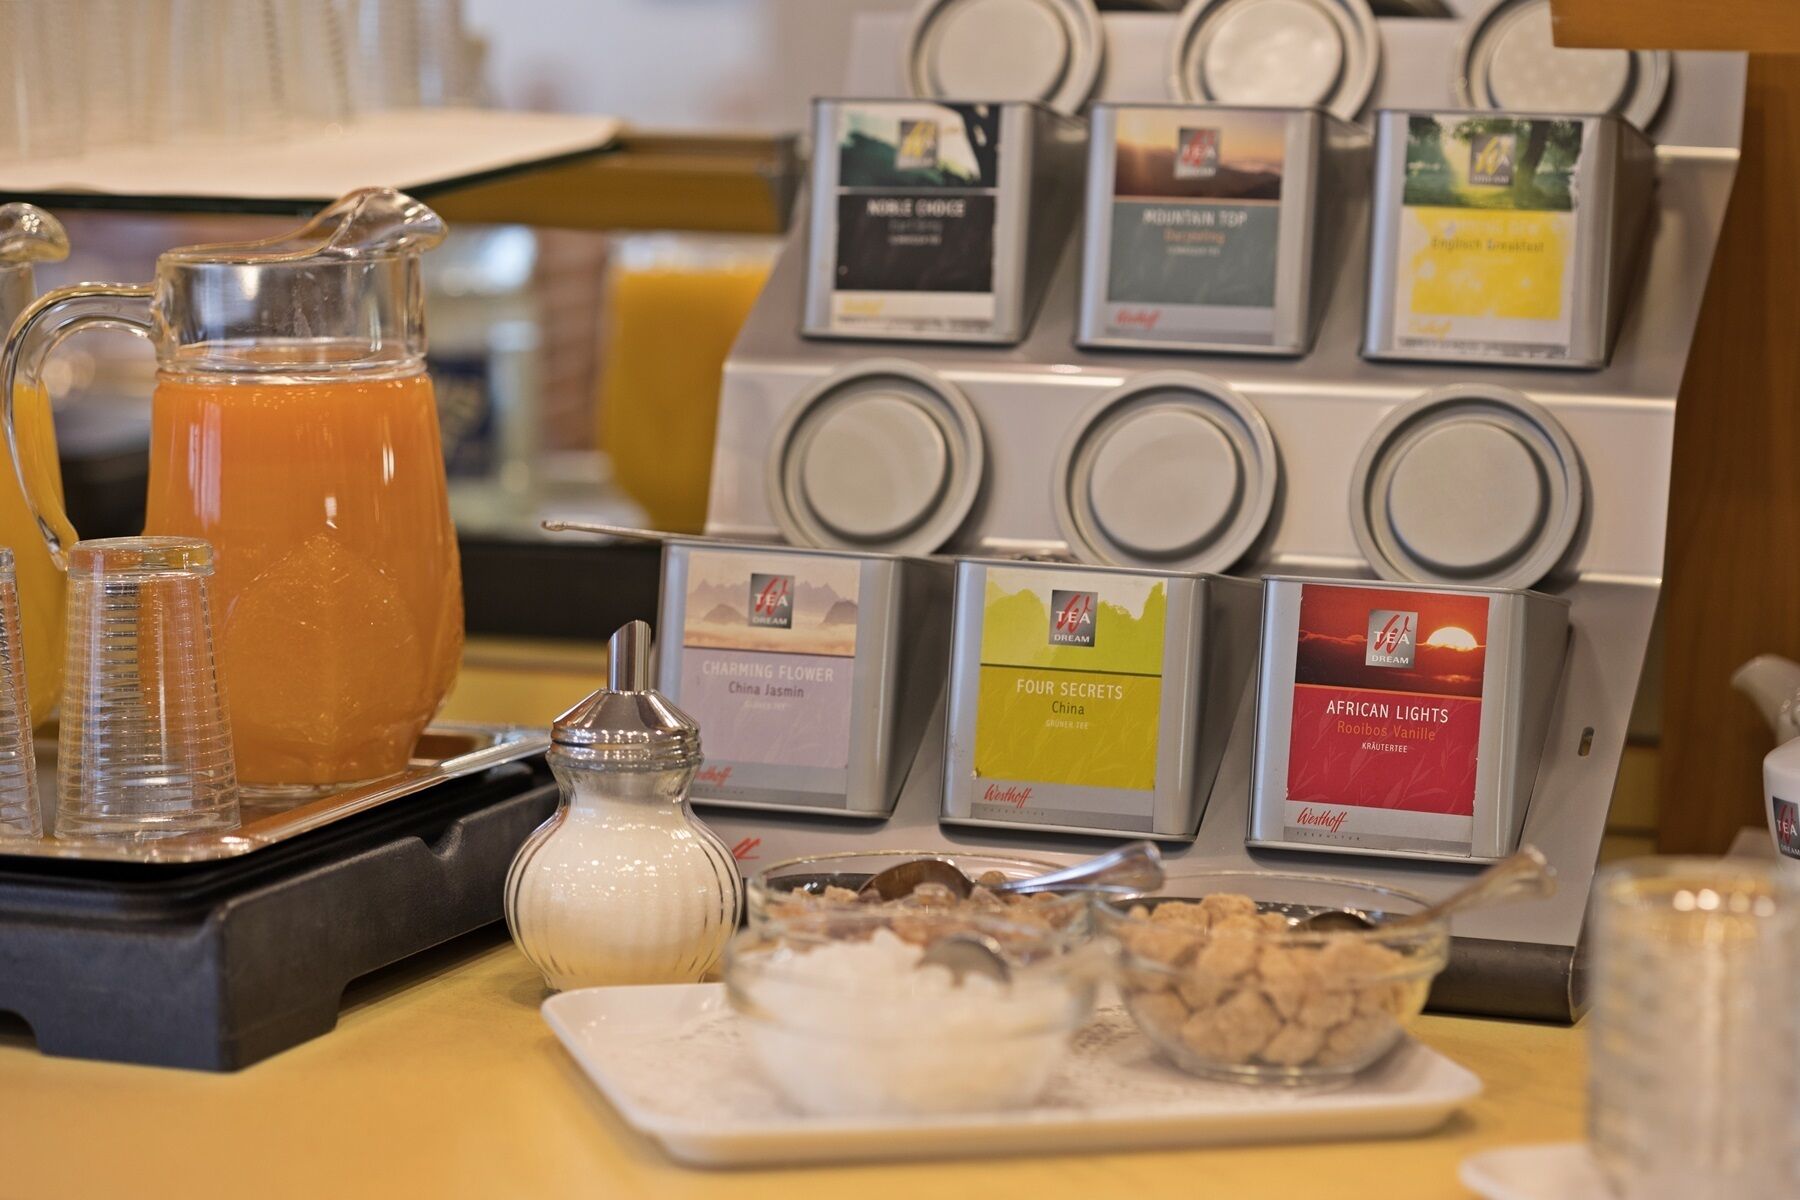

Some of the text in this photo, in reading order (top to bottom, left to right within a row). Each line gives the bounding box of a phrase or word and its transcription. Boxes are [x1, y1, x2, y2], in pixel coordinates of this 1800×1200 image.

[1143, 209, 1247, 227] MOUNTAIN TOP
[754, 593, 788, 607] TEA
[752, 617, 787, 625] DREAM
[1056, 610, 1091, 624] TEA
[1054, 634, 1090, 643] DREAM
[1373, 631, 1410, 645] TEA
[1371, 655, 1409, 664] DREAM
[702, 660, 833, 682] CHARMING FLOWER
[728, 681, 804, 698] China Jasmin
[1016, 679, 1123, 700] FOUR SECRETS
[1051, 700, 1085, 715] China
[1326, 700, 1449, 723] AFRICAN LIGHTS
[1337, 721, 1436, 741] Rooibos Vanille
[1361, 742, 1408, 753] KRÄUTERTEE
[984, 784, 1032, 808] Westhoff
[1297, 807, 1348, 832] Westhoff
[1776, 819, 1798, 836] TEA
